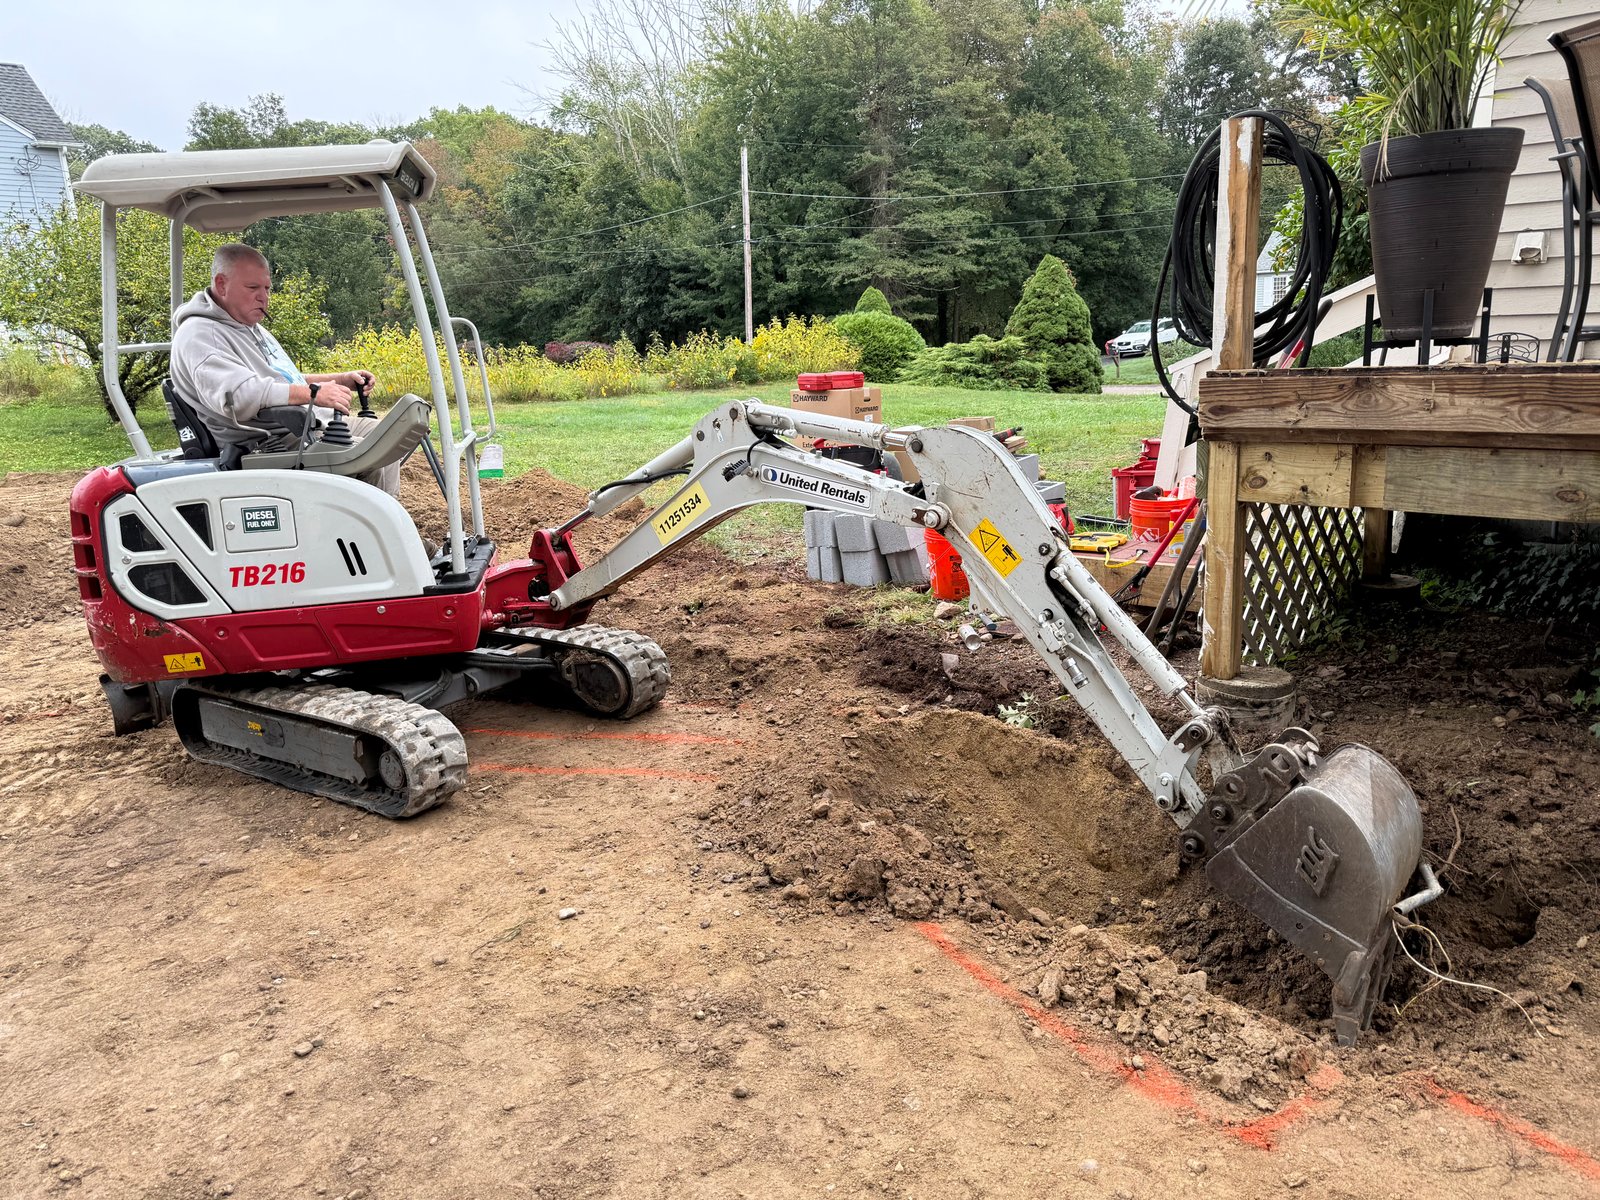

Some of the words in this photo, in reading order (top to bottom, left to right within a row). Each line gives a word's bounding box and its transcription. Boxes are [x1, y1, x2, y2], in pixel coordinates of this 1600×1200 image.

[780, 472, 819, 492] United
[820, 482, 866, 504] Rentals
[245, 510, 276, 520] DIESEL
[659, 493, 702, 534] 11251534
[229, 561, 306, 588] TB216
